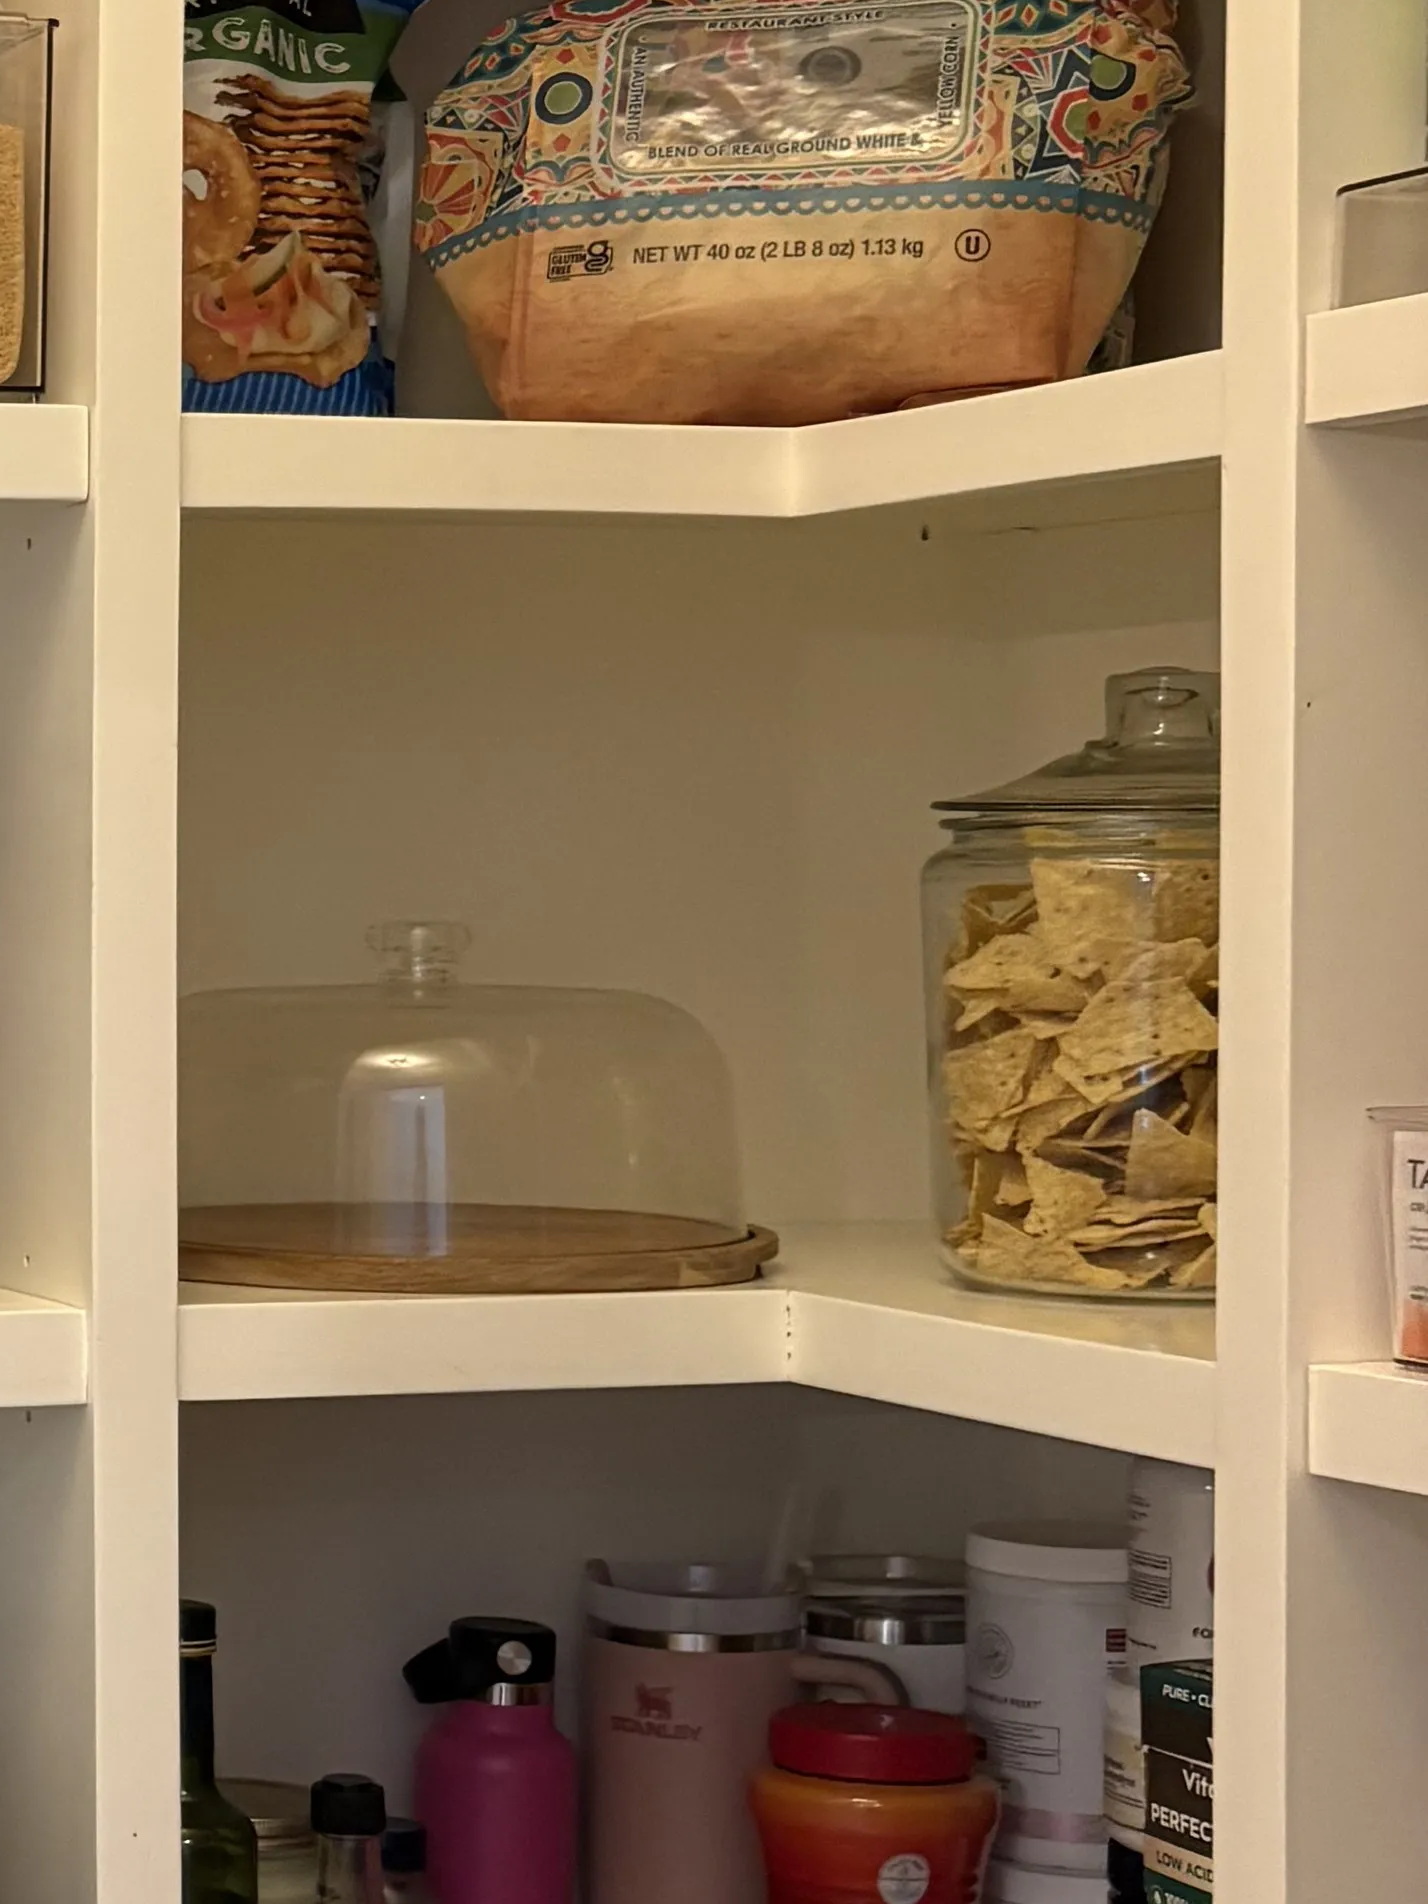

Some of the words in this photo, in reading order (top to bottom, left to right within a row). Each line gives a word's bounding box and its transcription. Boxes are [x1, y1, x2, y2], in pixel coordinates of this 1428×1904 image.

[943, 34, 960, 73] CORN
[648, 143, 699, 160] BLEND
[705, 142, 728, 157] OF
[731, 141, 771, 157] REAL
[774, 137, 852, 154] GROUND
[856, 132, 910, 149] WHITE
[633, 245, 669, 264] NET
[672, 244, 701, 262] WT
[707, 243, 731, 261] 40
[734, 245, 756, 260] oz
[760, 241, 778, 264] (2
[782, 241, 807, 259] LB
[811, 240, 826, 258] 8
[829, 239, 855, 260] oz)
[860, 238, 897, 257] 1.13
[901, 237, 925, 259] kg
[1162, 1683, 1190, 1703] PURE
[1156, 1849, 1183, 1872] LOW
